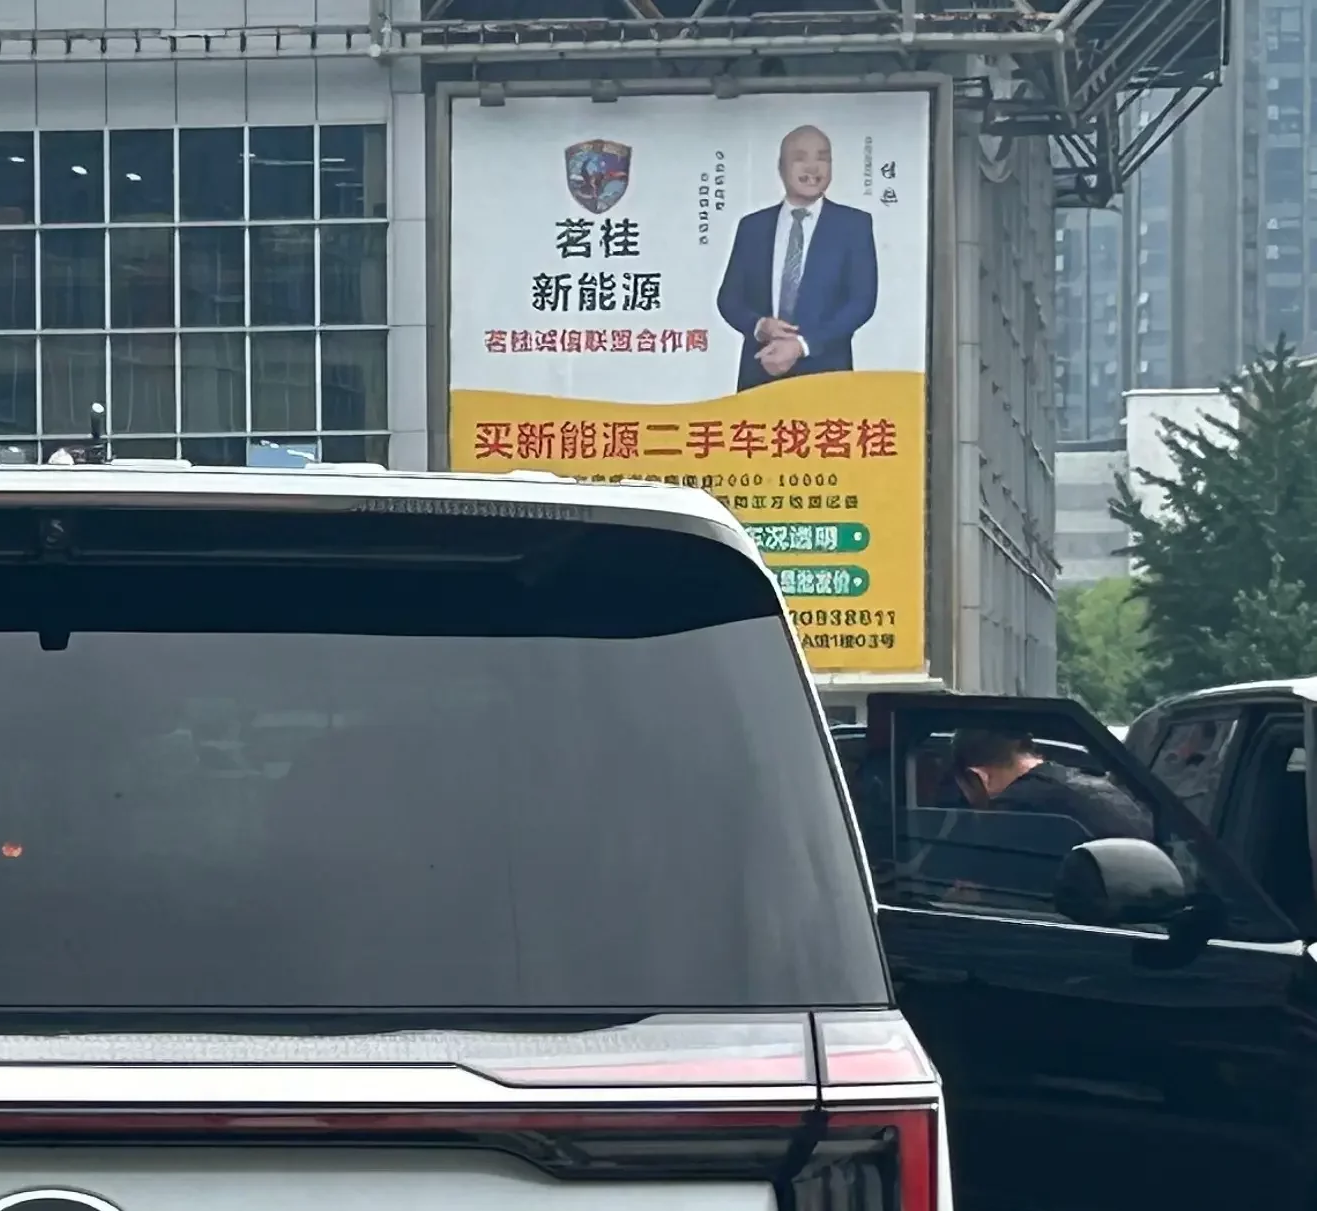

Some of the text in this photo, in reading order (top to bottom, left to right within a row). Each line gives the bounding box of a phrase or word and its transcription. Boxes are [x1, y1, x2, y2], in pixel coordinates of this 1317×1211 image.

[555, 217, 641, 259] 茗桂
[531, 271, 662, 312] 新能源
[474, 418, 899, 460] 买新能源二手车找茗桂
